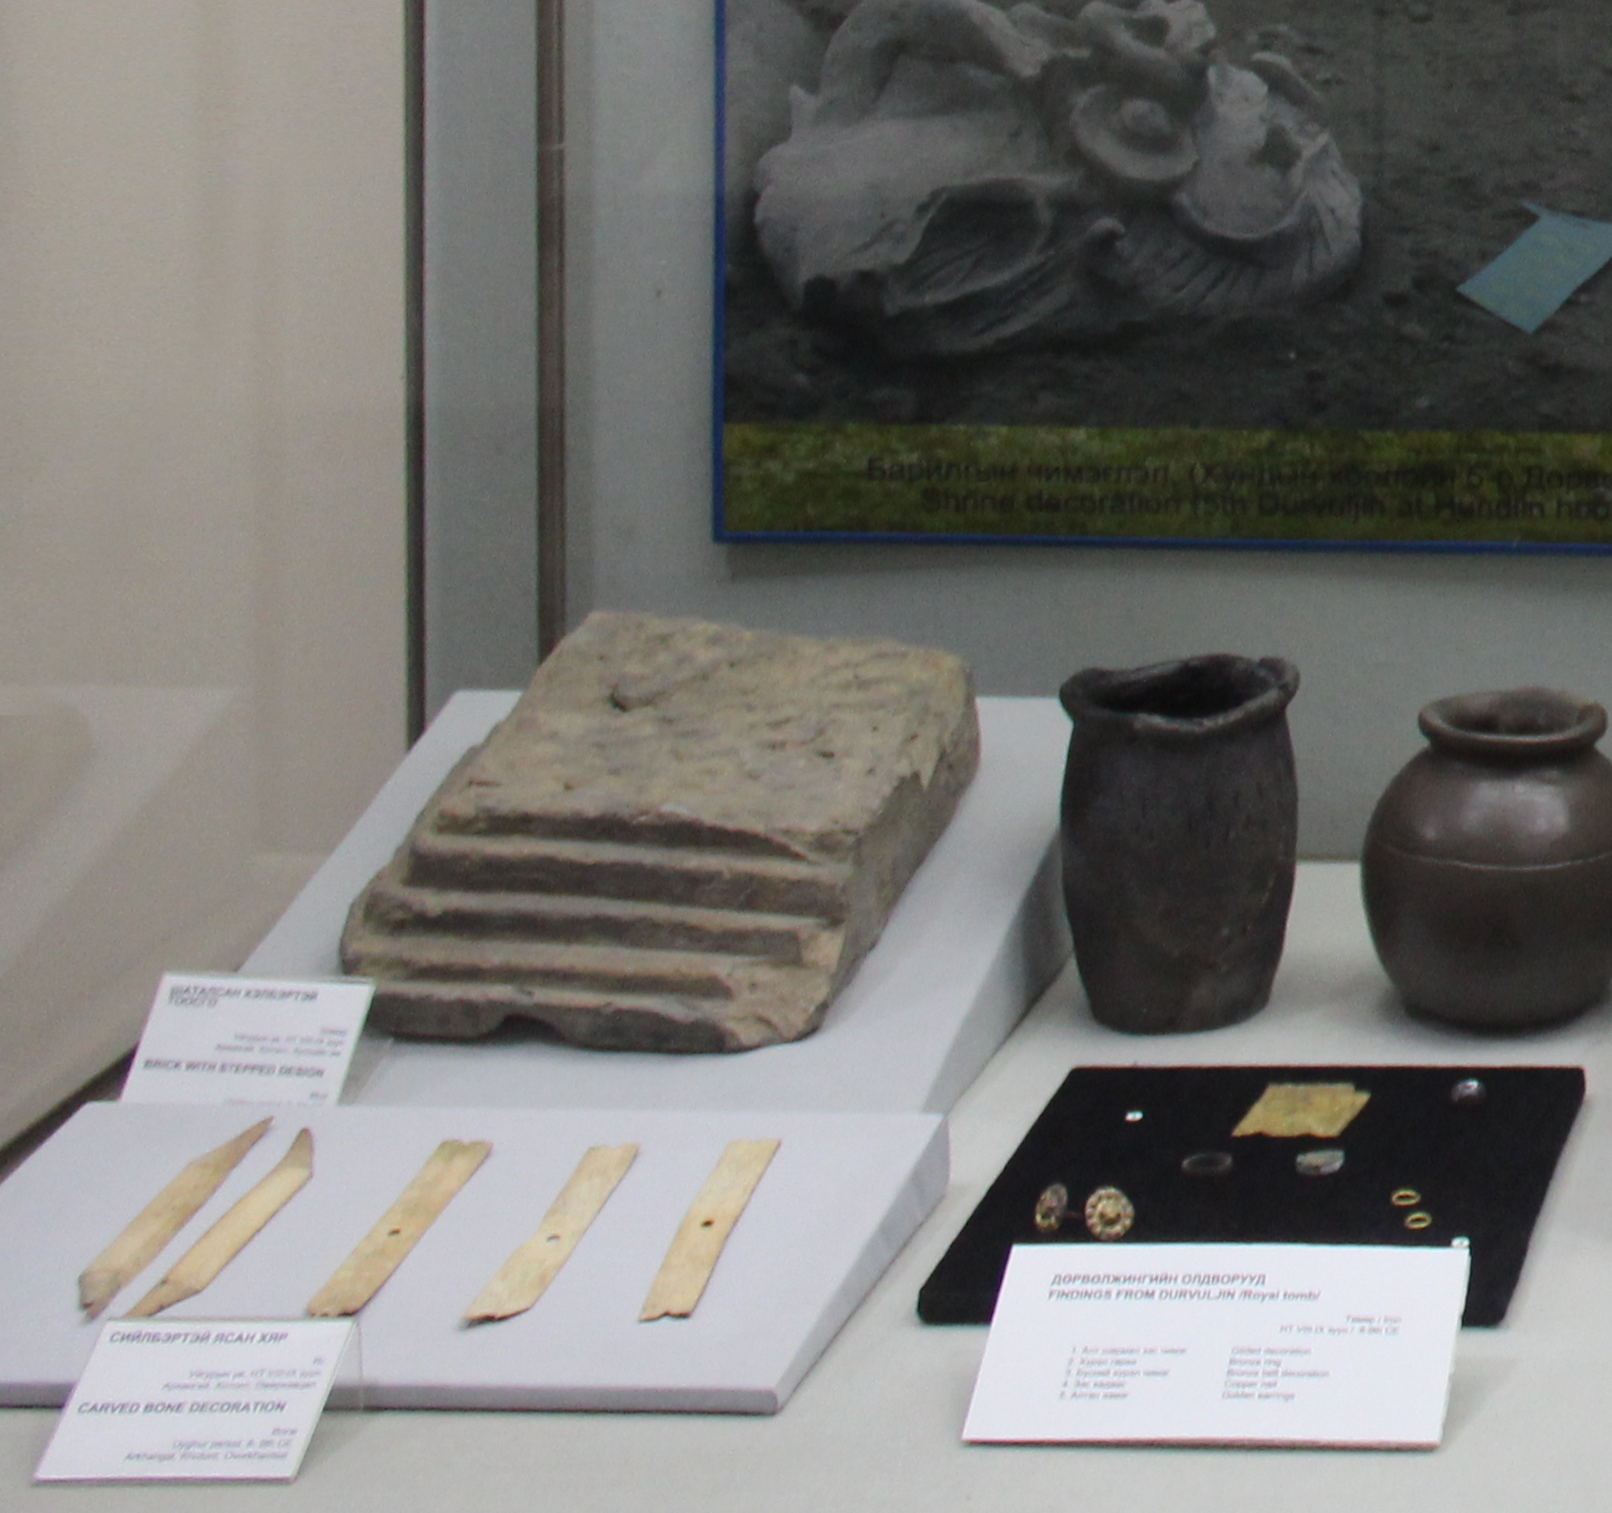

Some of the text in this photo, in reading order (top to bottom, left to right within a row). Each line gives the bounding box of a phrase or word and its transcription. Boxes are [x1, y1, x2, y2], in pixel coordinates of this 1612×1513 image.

[1048, 1289, 1112, 1300] FINDINGS
[1115, 1289, 1156, 1300] FROM
[1158, 1289, 1236, 1301] DURVULJIN
[77, 1400, 287, 1414] CARVED BONE DECORATION
